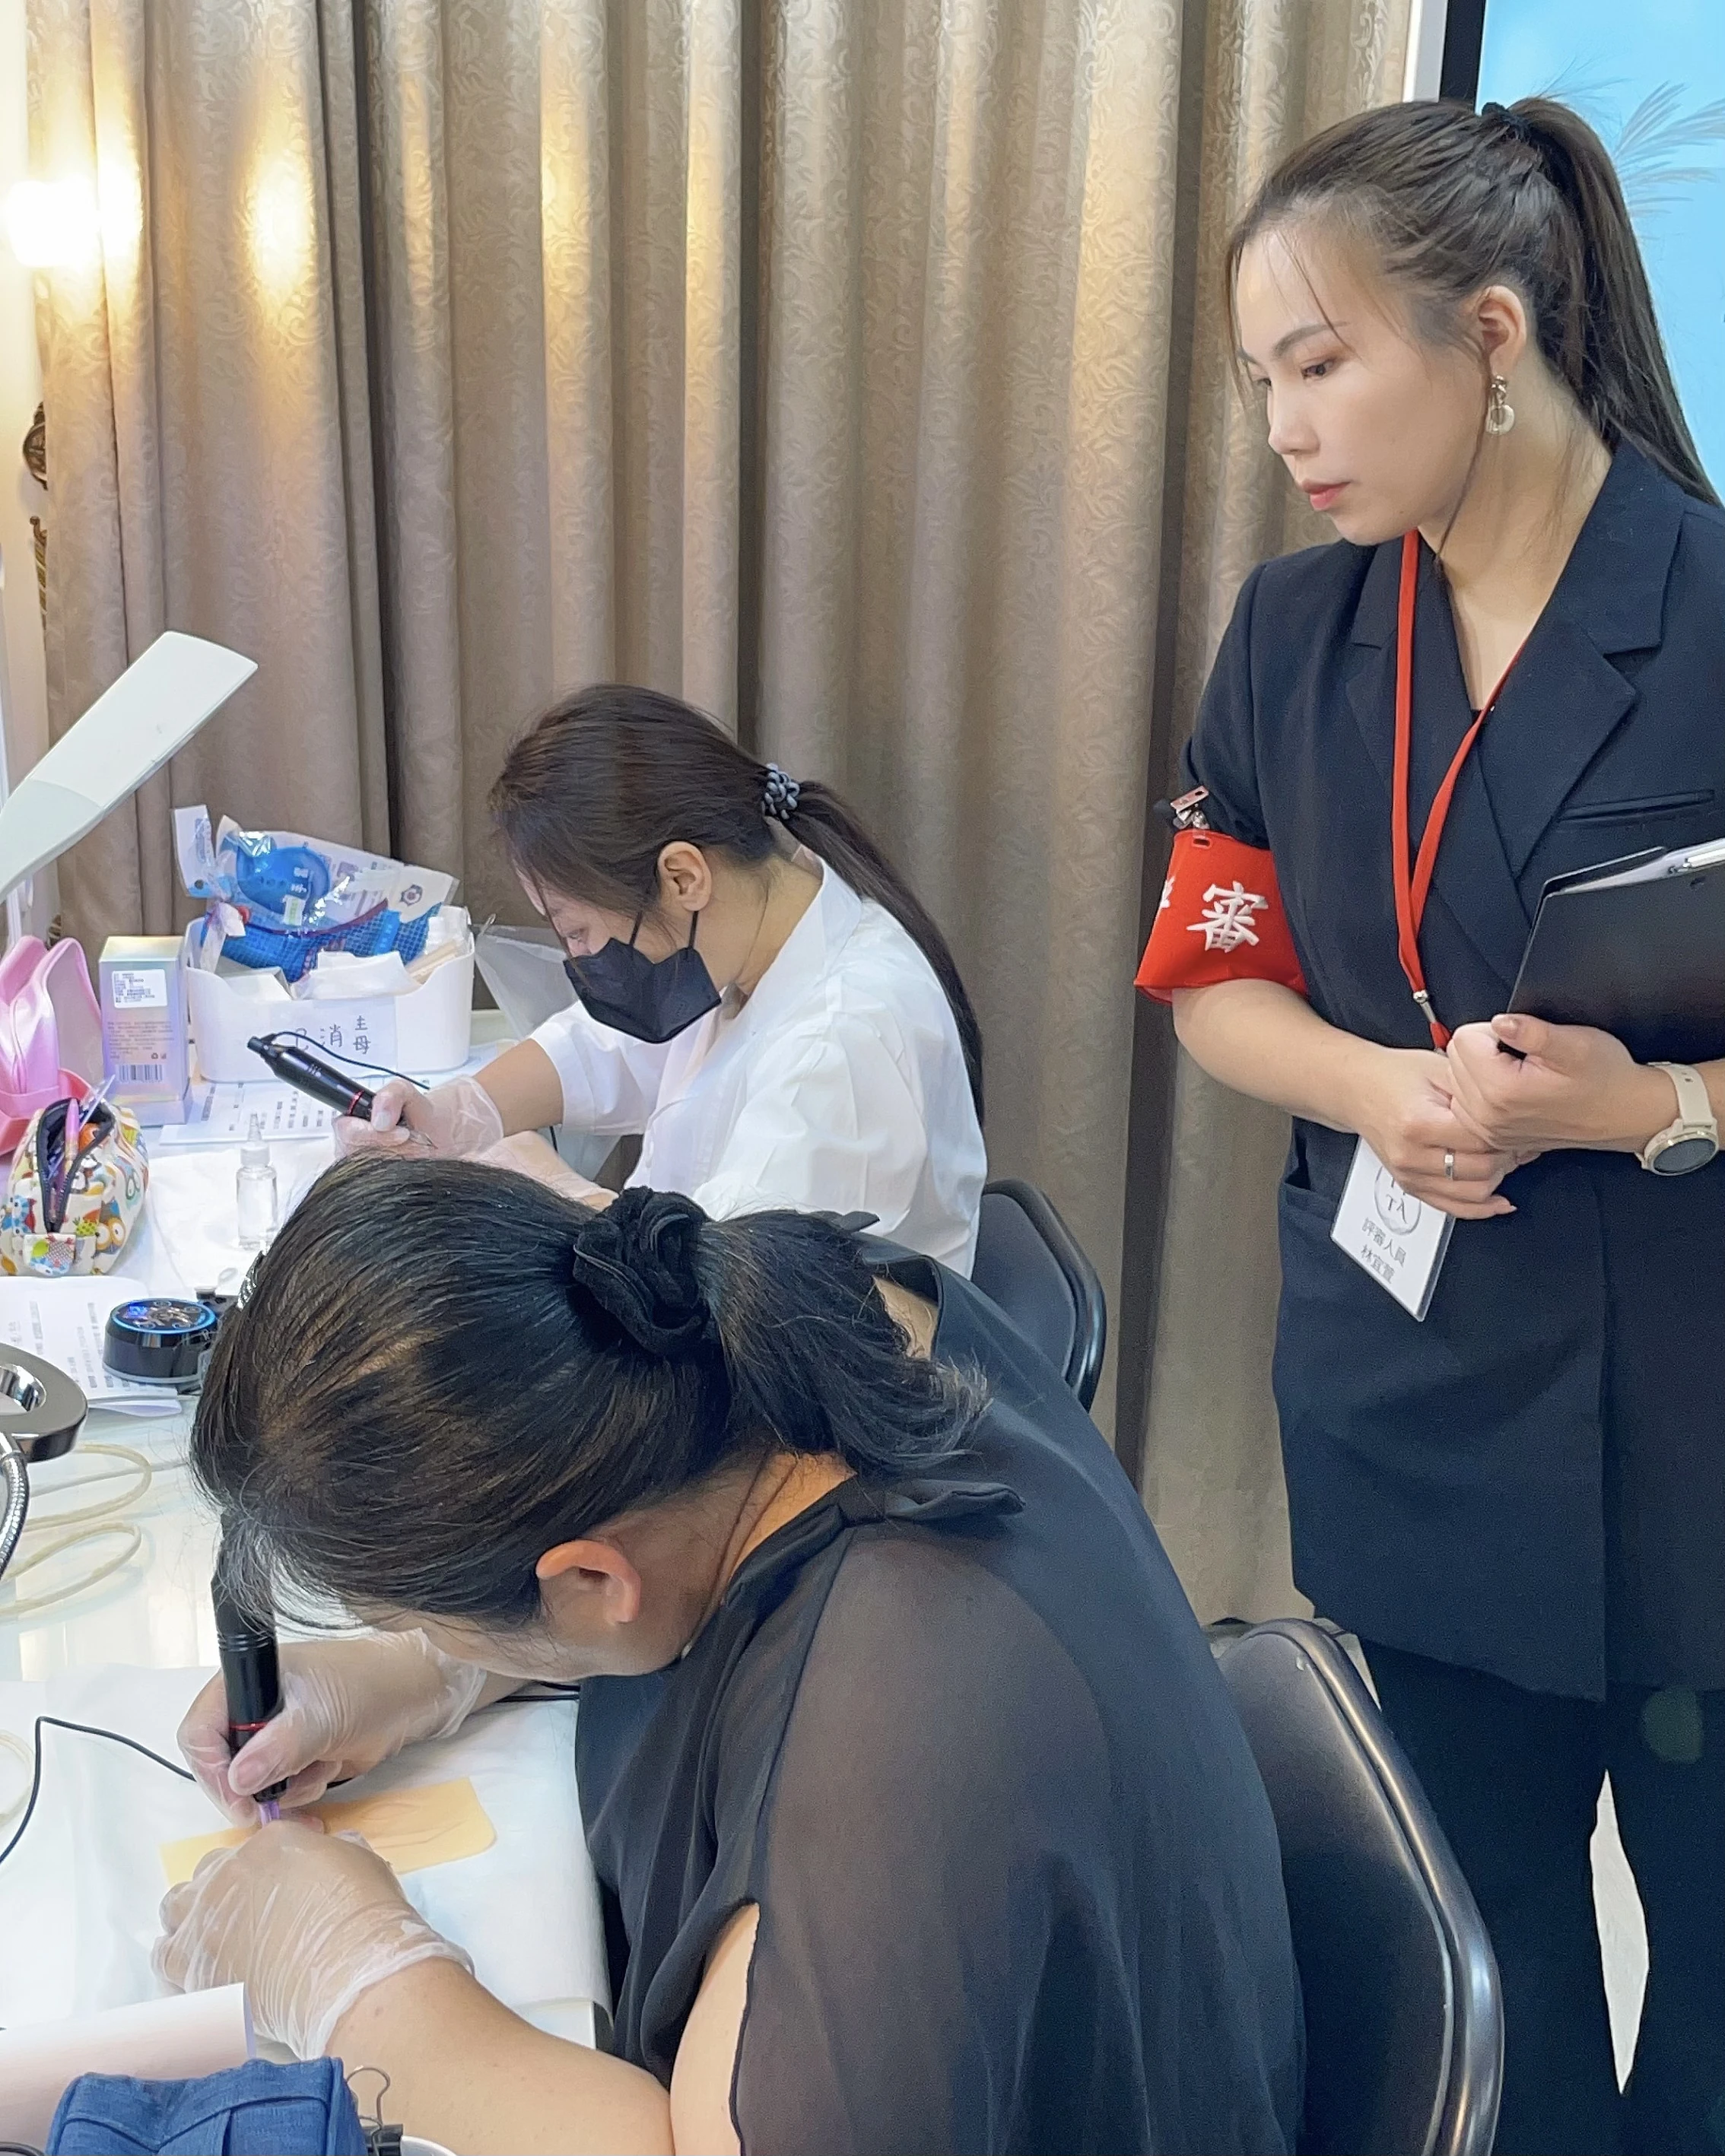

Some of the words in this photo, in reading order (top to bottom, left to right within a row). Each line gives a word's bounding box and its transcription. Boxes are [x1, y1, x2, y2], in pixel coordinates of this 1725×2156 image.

[1160, 876, 1269, 953] 審
[1361, 1217, 1407, 1268] 評審人員
